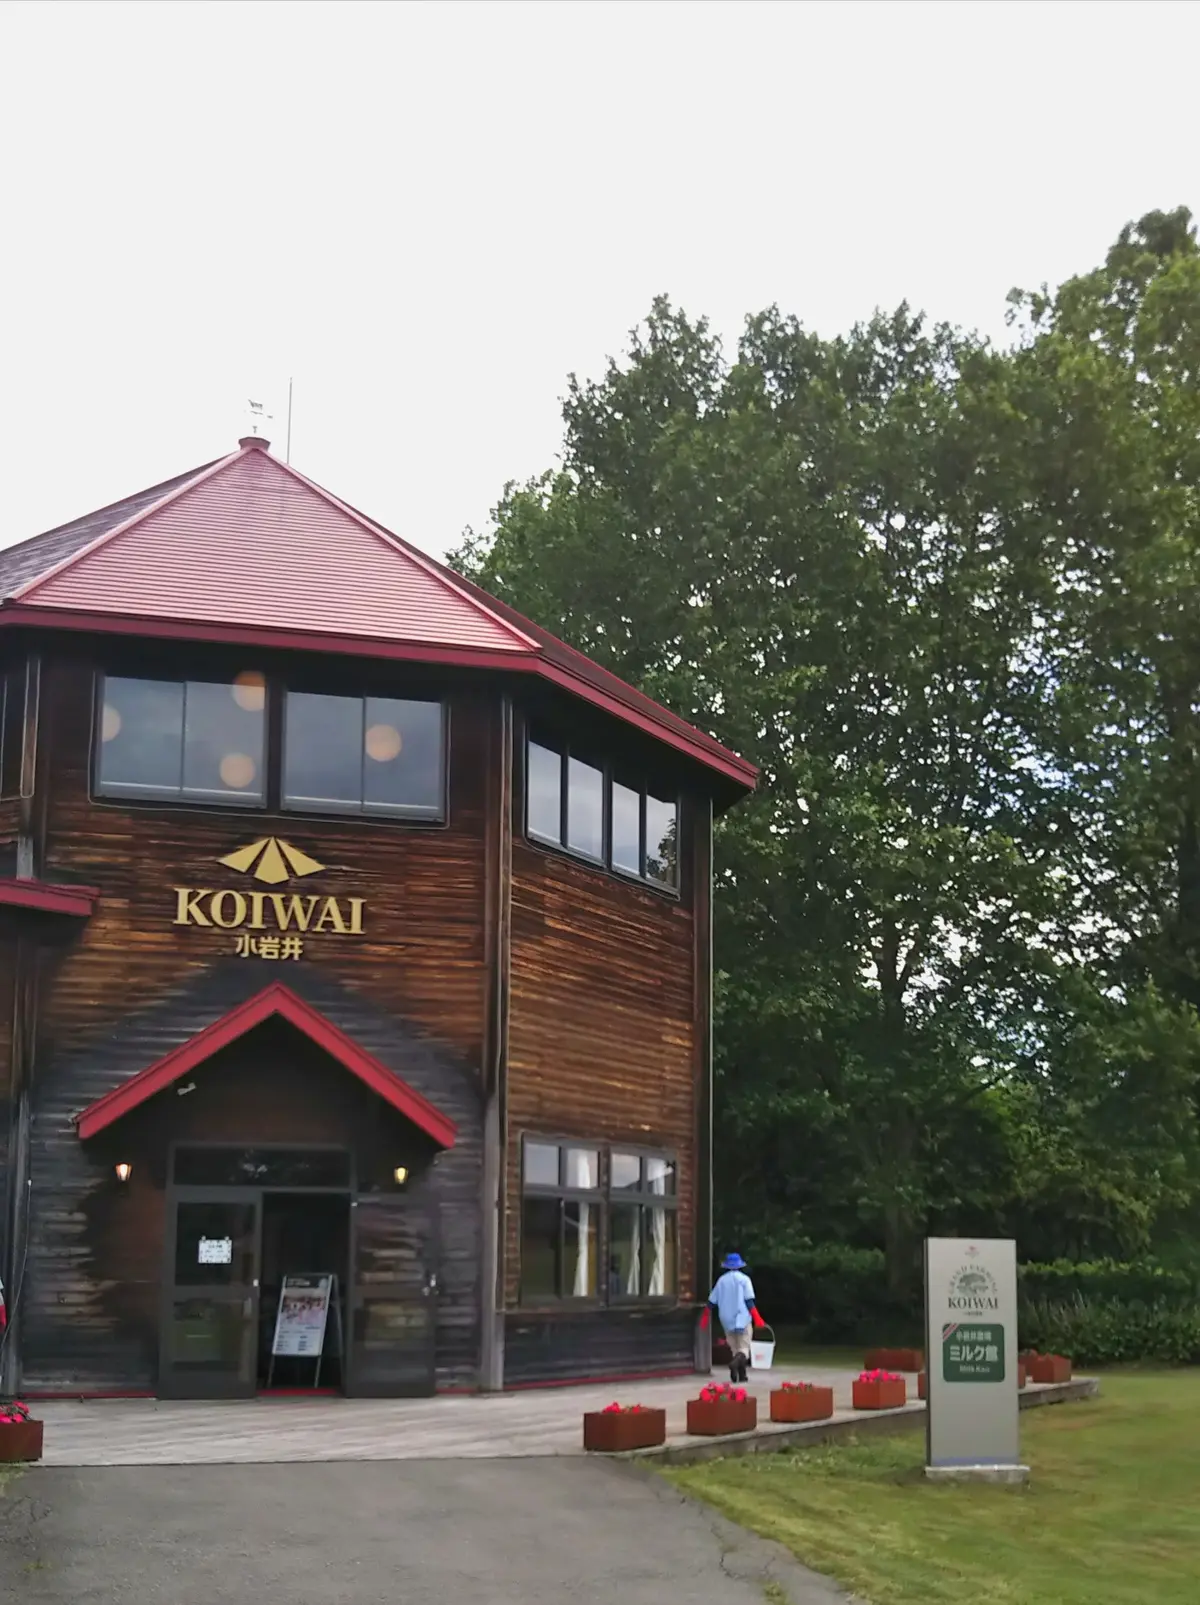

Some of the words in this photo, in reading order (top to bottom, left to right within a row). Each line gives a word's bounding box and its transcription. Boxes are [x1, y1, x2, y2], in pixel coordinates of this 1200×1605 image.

[173, 887, 367, 935] KOIWAI
[235, 934, 304, 961] 小岩井
[947, 1297, 999, 1310] KOIWAI
